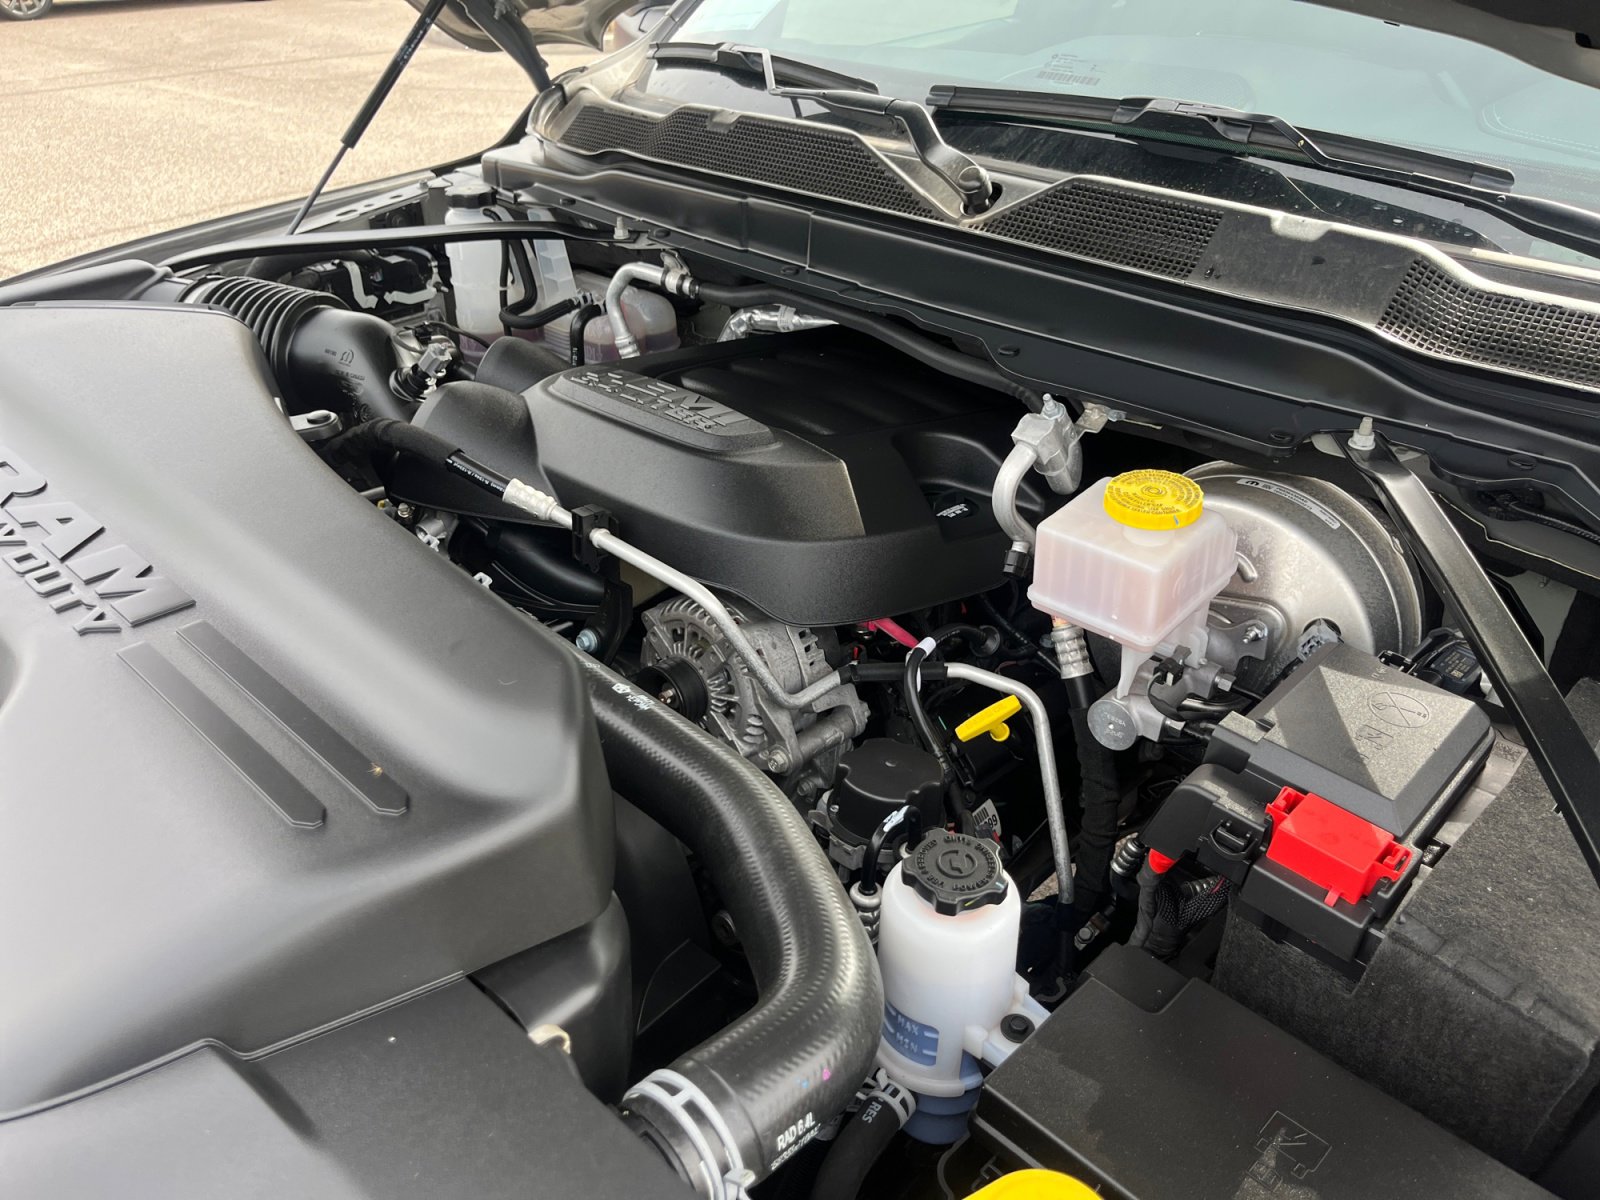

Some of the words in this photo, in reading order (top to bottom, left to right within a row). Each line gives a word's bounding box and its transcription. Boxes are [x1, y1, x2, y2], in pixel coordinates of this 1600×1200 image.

[587, 368, 750, 426] HEMI
[0, 447, 196, 627] RAM
[1, 548, 122, 636] DUTY
[897, 1014, 919, 1036] MAX
[896, 1032, 918, 1053] MIN
[862, 1101, 882, 1124] RES
[776, 1124, 797, 1152] RAD
